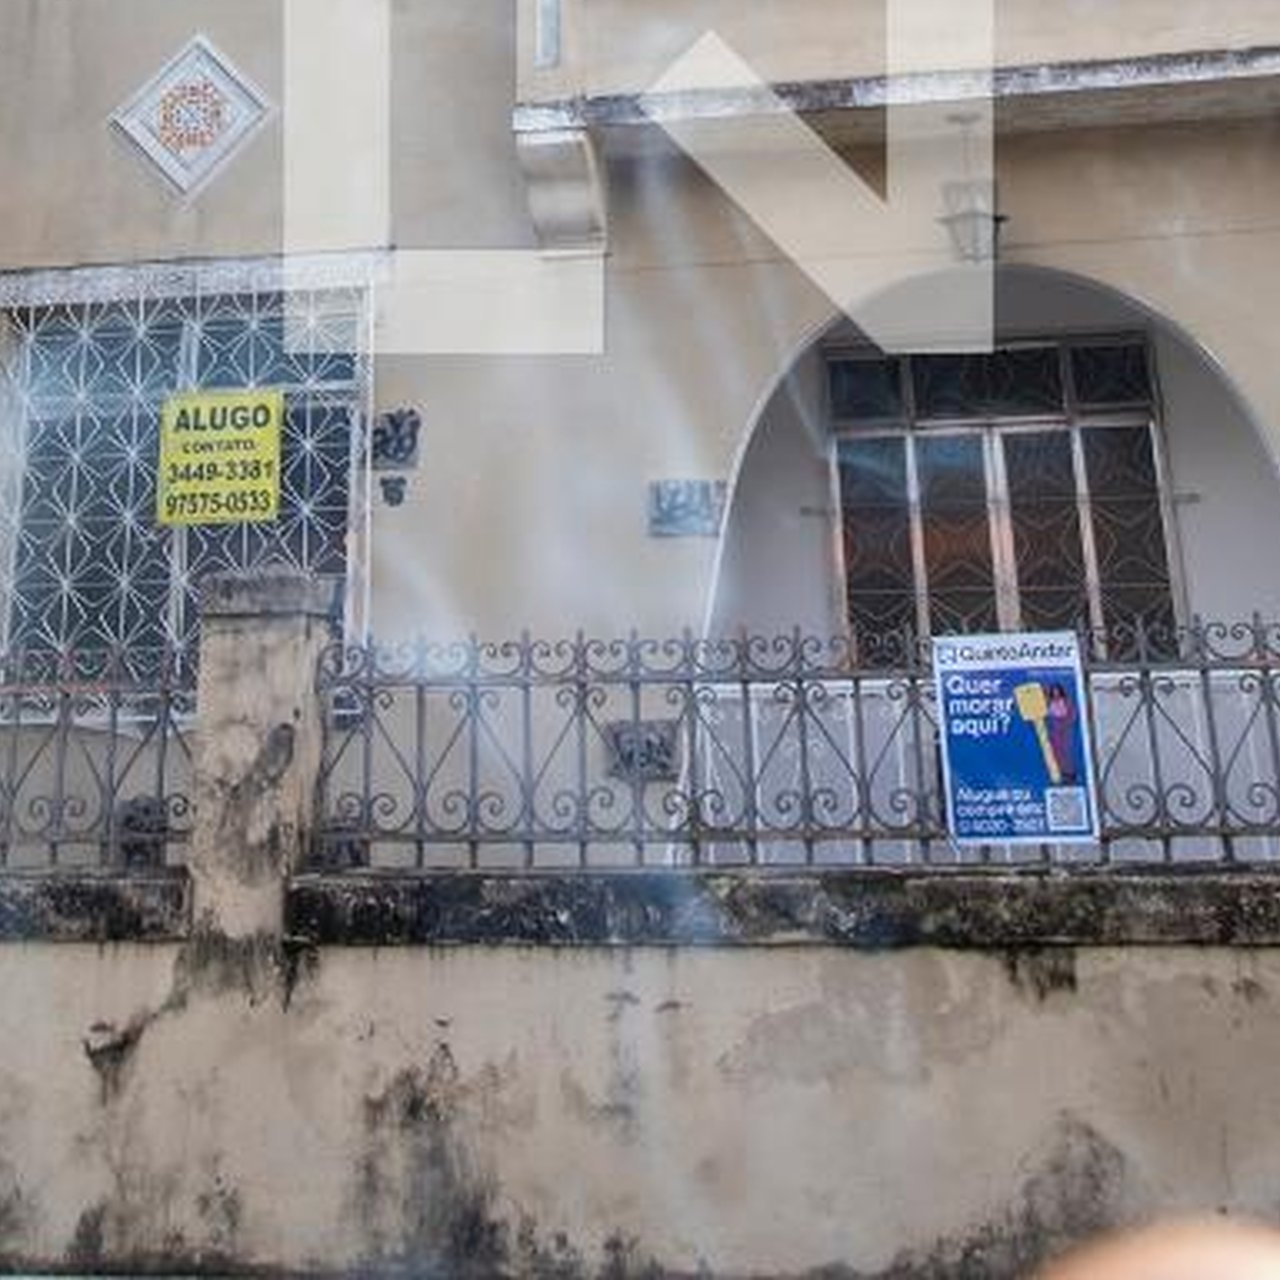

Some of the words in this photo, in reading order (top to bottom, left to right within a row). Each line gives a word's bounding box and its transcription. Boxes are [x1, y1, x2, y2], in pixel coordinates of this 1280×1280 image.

[174, 404, 271, 432] ALUGO
[946, 676, 1001, 695] Quer
[949, 696, 1013, 715] morar
[952, 714, 1011, 736] aqui?
